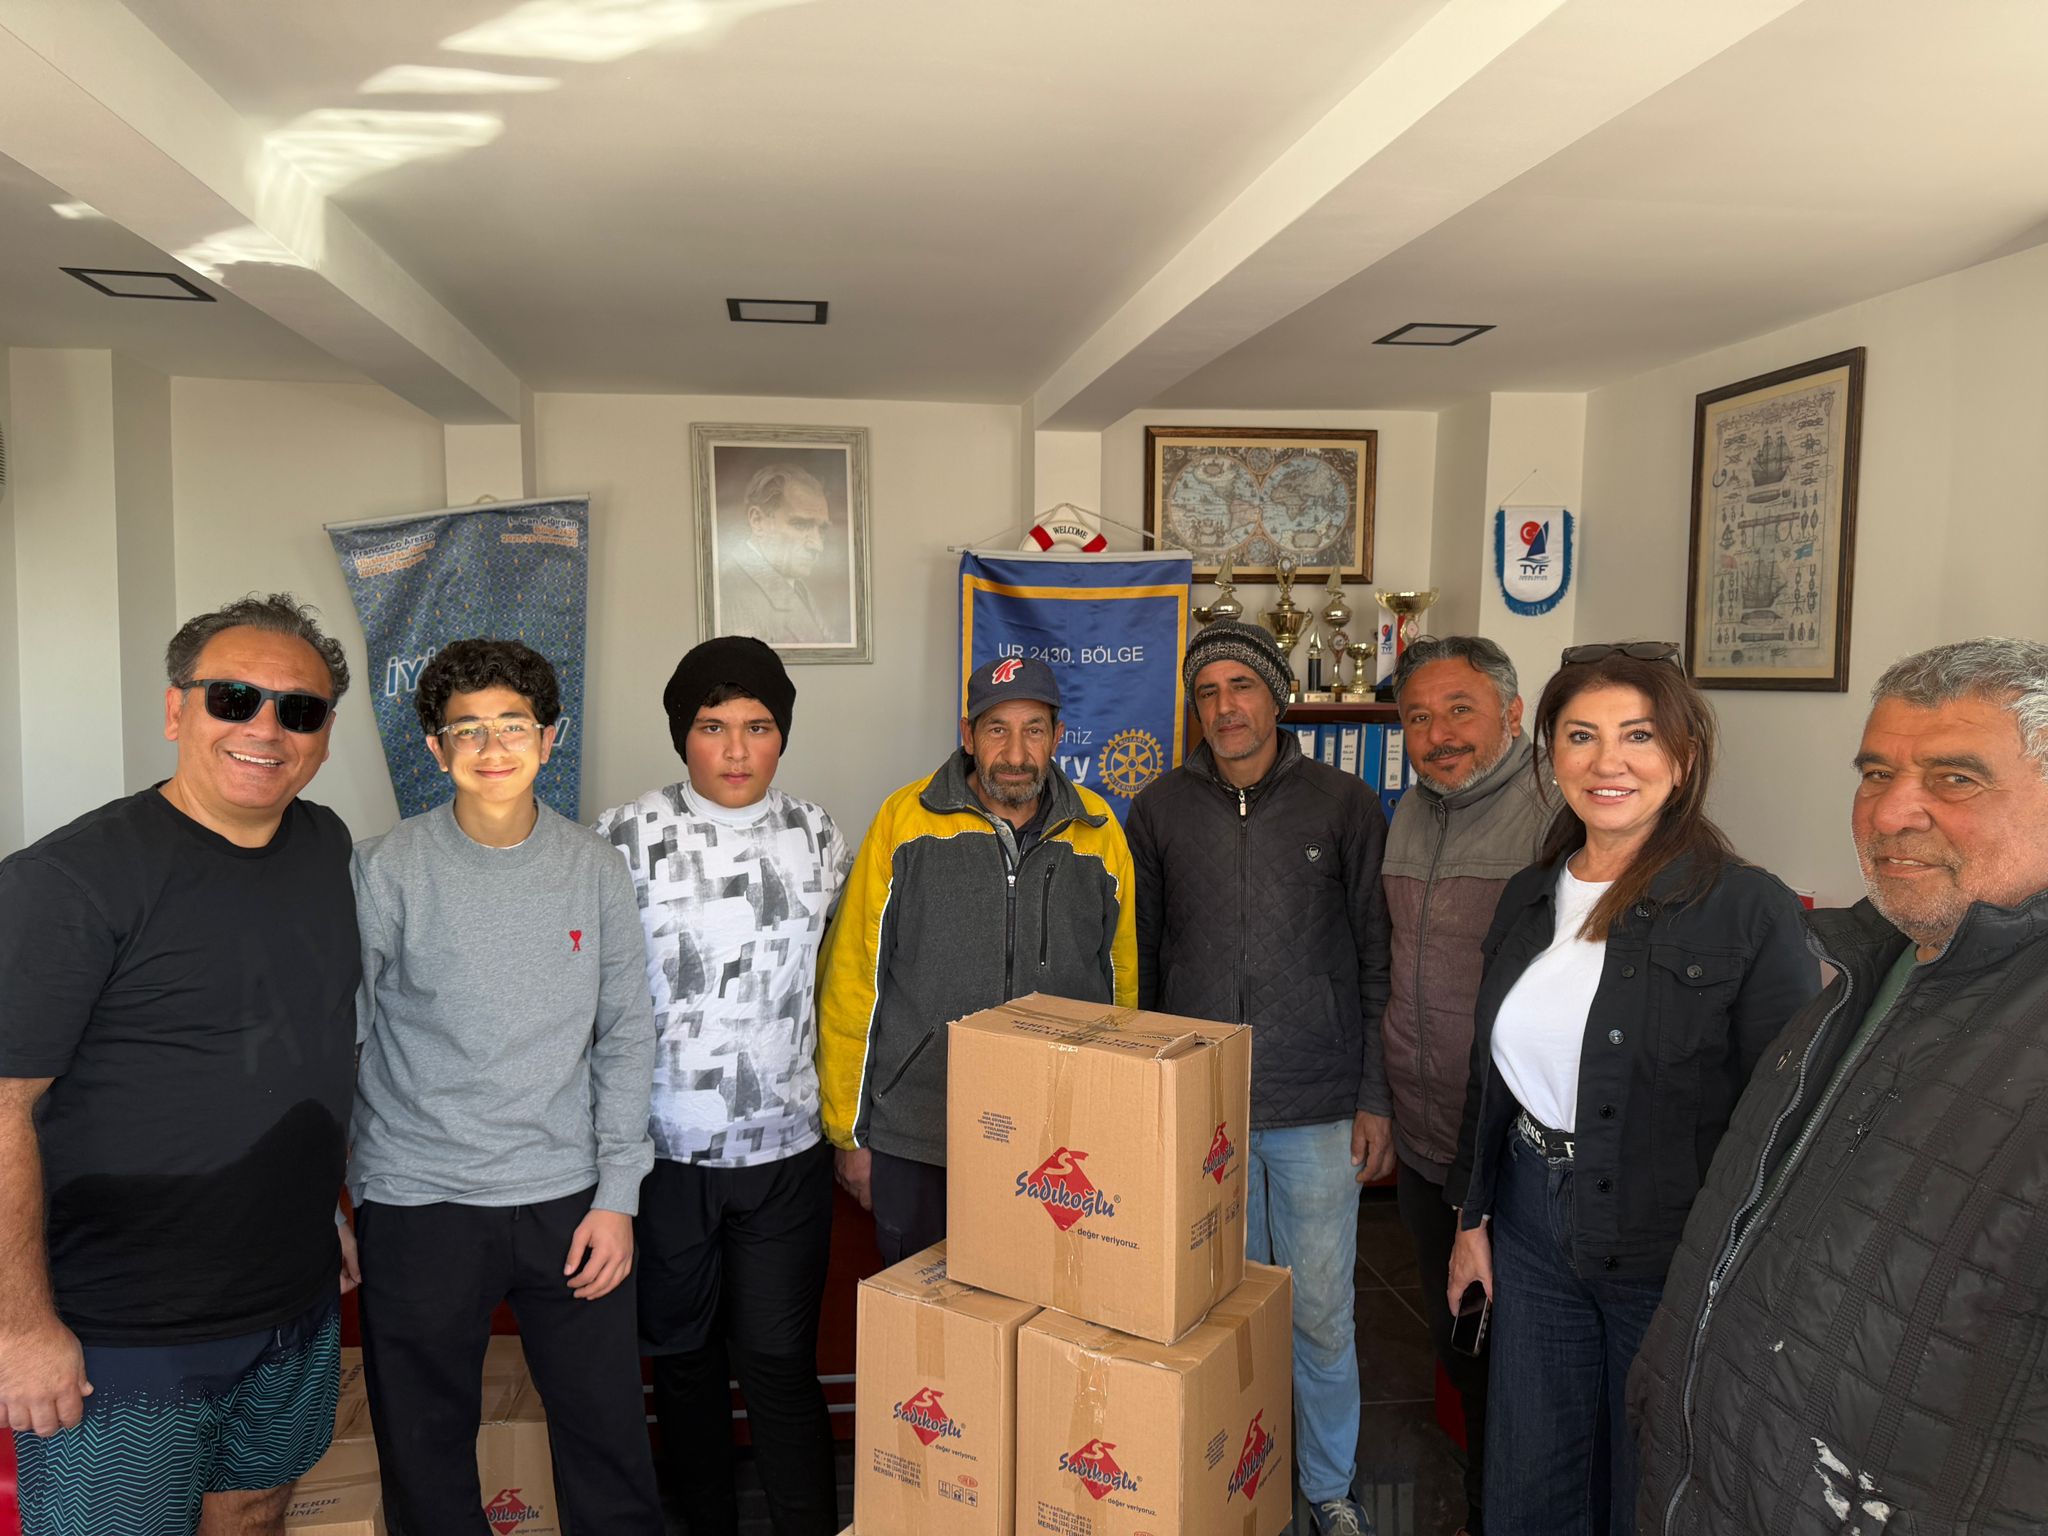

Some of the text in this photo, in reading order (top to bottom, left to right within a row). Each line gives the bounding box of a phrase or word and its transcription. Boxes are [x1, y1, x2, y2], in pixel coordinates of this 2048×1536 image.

[1053, 525, 1088, 540] WELCOME
[352, 532, 435, 559] Francesco Arezzo
[1519, 564, 1549, 575] TYF
[998, 642, 1144, 664] UR 2430. BÖLGE
[1015, 1170, 1115, 1218] Sadıkoğlu
[1077, 1227, 1099, 1240] değer
[1101, 1233, 1140, 1249] veriyoruz.
[893, 1401, 961, 1438] Sadıkoğlu
[1058, 1452, 1138, 1492] Sadıkoğlu
[490, 1505, 540, 1522] dıkoğlu
